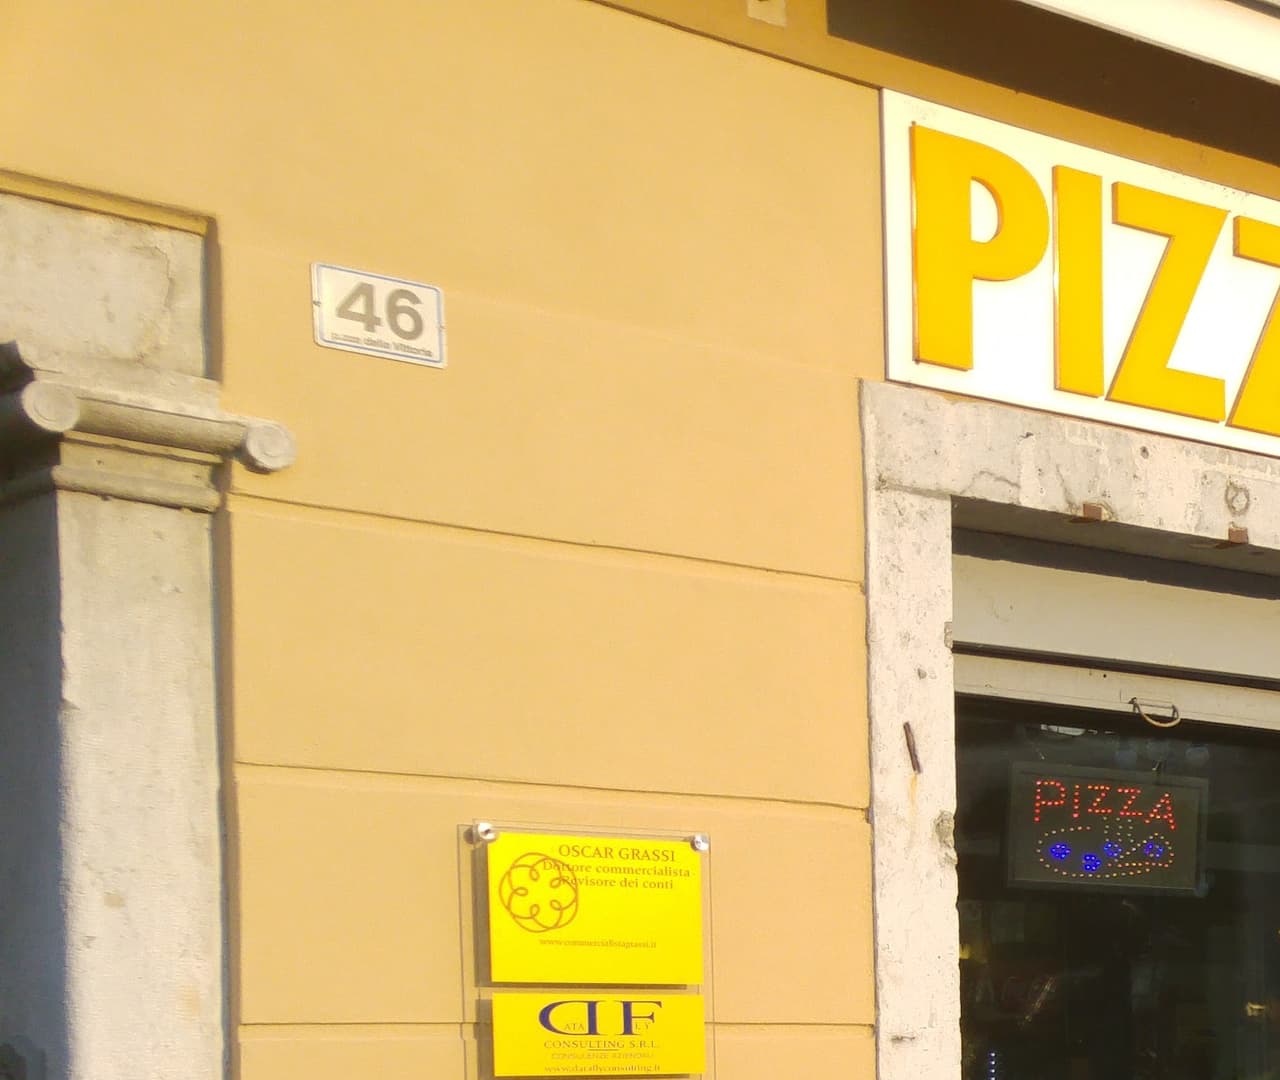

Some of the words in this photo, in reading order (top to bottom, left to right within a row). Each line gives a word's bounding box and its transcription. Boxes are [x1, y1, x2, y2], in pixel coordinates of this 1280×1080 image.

[335, 281, 424, 341] 46
[1034, 779, 1176, 830] PIZZA
[558, 844, 614, 859] OSCAR
[618, 848, 675, 862] GRASSI
[543, 861, 593, 872] Dottore
[596, 863, 691, 878] commercialista
[561, 876, 616, 888] Revisore
[620, 877, 639, 888] dei
[642, 880, 673, 890] conti
[544, 1039, 625, 1049] CONSULTING
